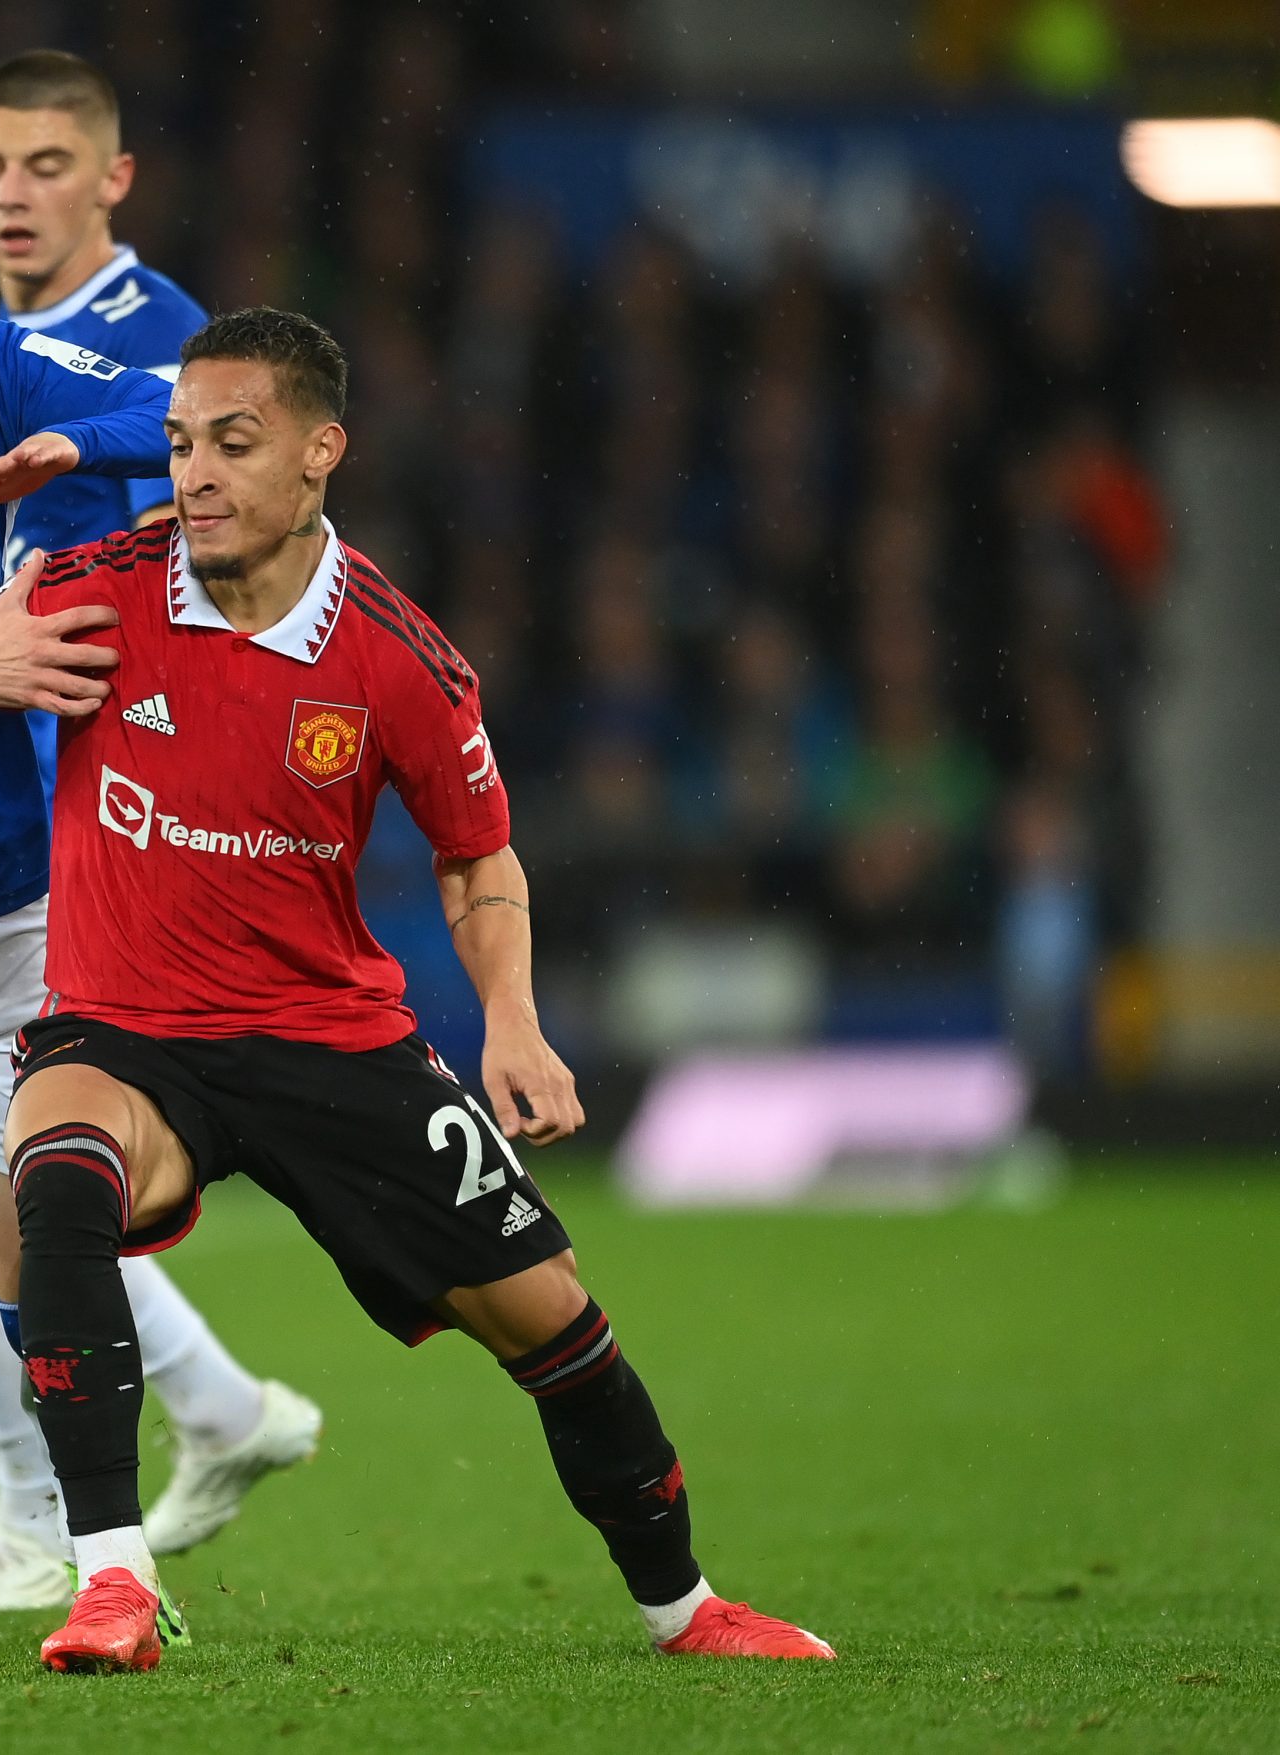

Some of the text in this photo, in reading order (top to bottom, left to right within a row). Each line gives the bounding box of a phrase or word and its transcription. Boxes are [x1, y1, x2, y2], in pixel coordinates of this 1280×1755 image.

[122, 709, 176, 736] adidas
[303, 717, 351, 740] MANCHESTER
[306, 758, 340, 771] UNITED
[155, 812, 344, 862] TeamViewer
[501, 1206, 542, 1238] adidas
